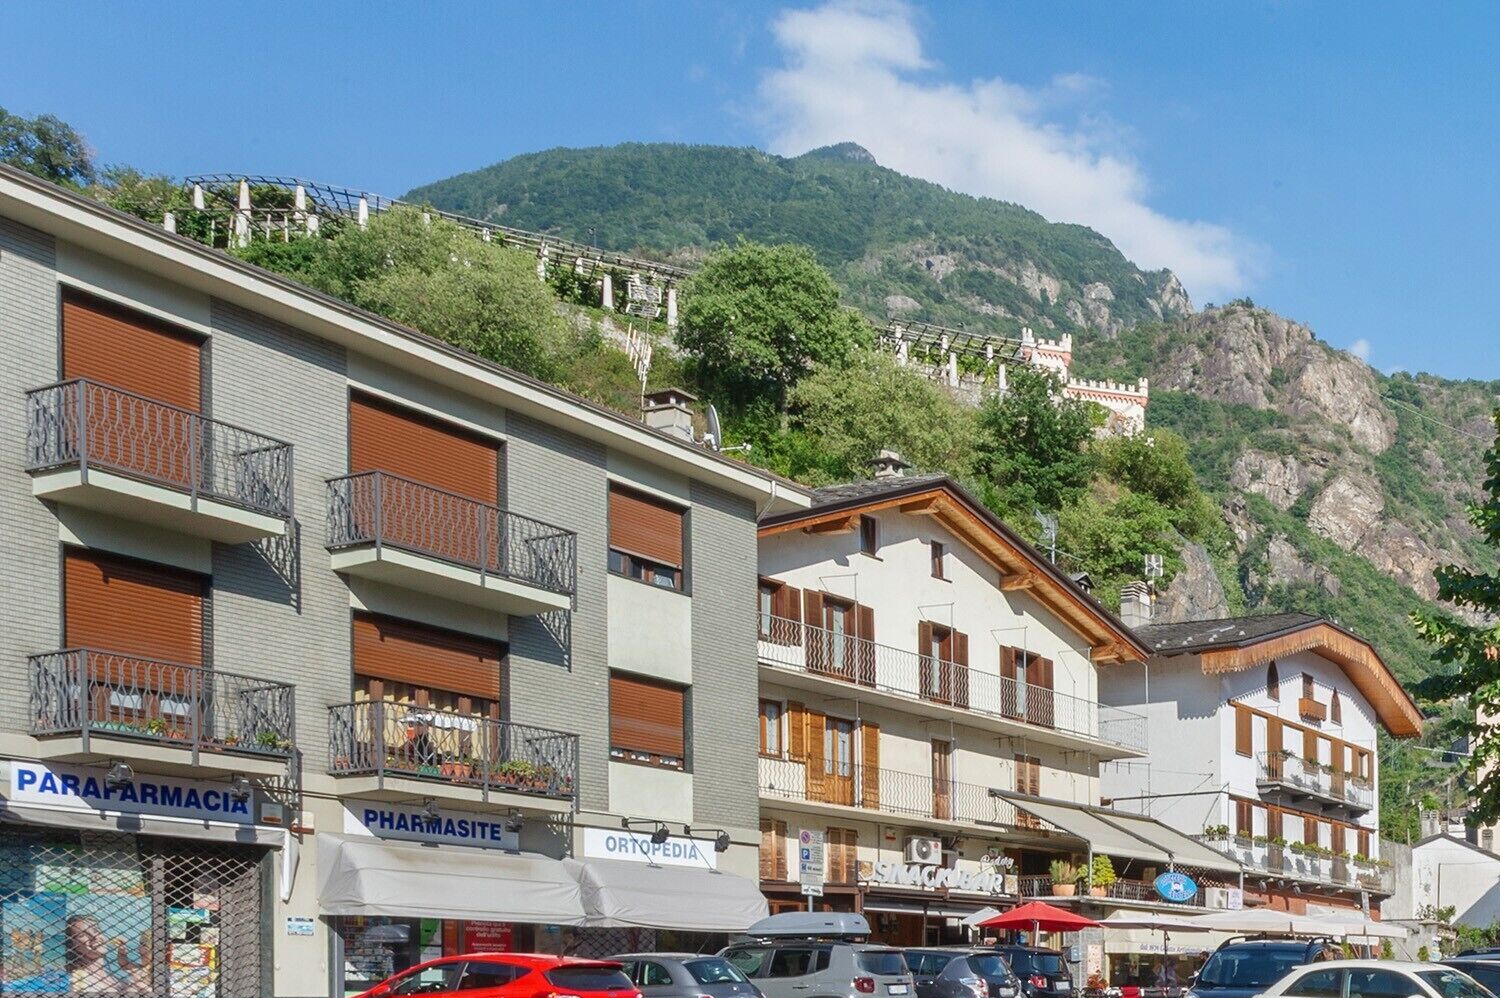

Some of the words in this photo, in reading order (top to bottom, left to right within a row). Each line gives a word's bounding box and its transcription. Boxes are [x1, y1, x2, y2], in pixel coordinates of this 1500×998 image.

[17, 769, 249, 815] PARAFARMACIA
[364, 808, 502, 842] PHARMASITE
[606, 835, 699, 861] ORTOPEDIA
[874, 861, 953, 888] SNACK
[959, 869, 1003, 893] BAR
